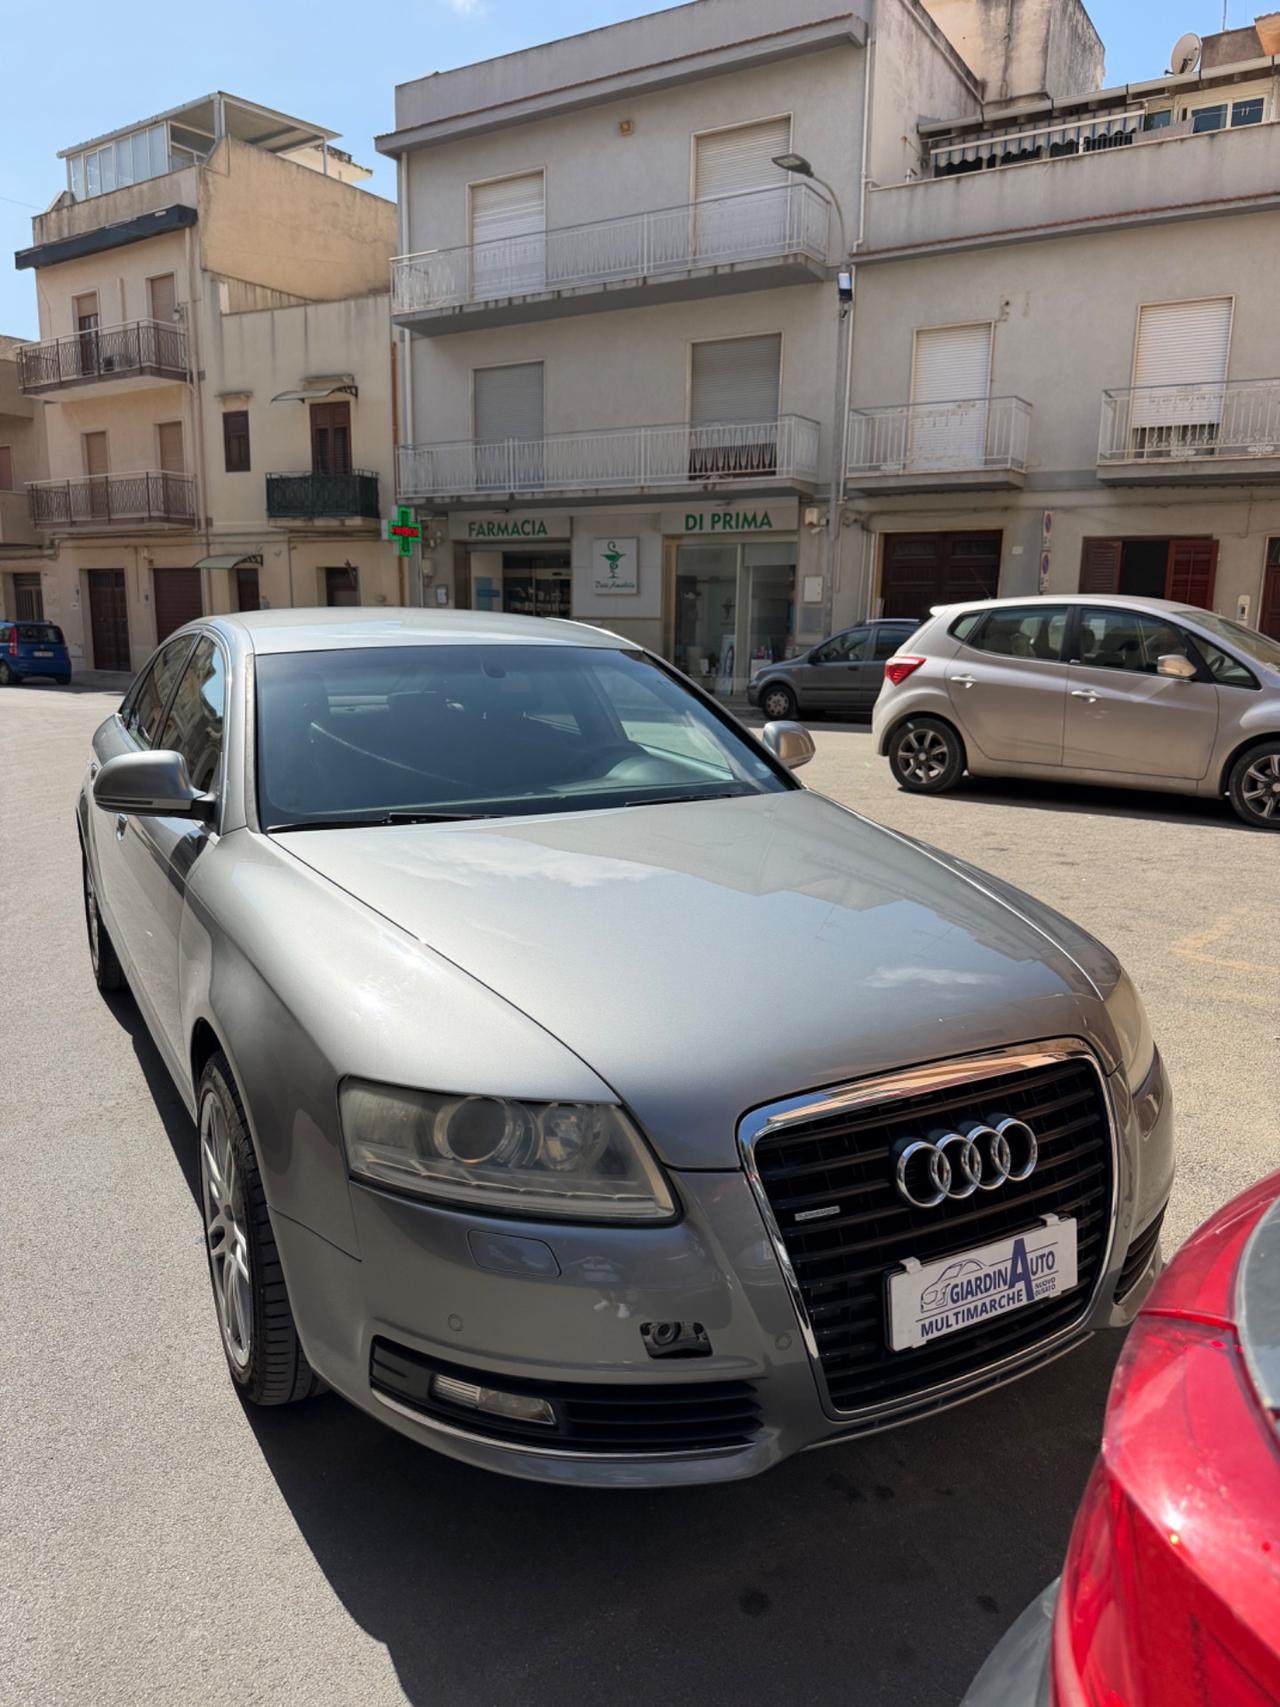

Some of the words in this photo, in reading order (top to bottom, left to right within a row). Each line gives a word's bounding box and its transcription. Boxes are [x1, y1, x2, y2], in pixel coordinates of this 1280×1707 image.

[468, 519, 548, 537] FARMACIA
[684, 513, 704, 531] DI
[710, 511, 773, 530] PRIMA
[920, 1289, 1023, 1338] MULTIMARCHE
